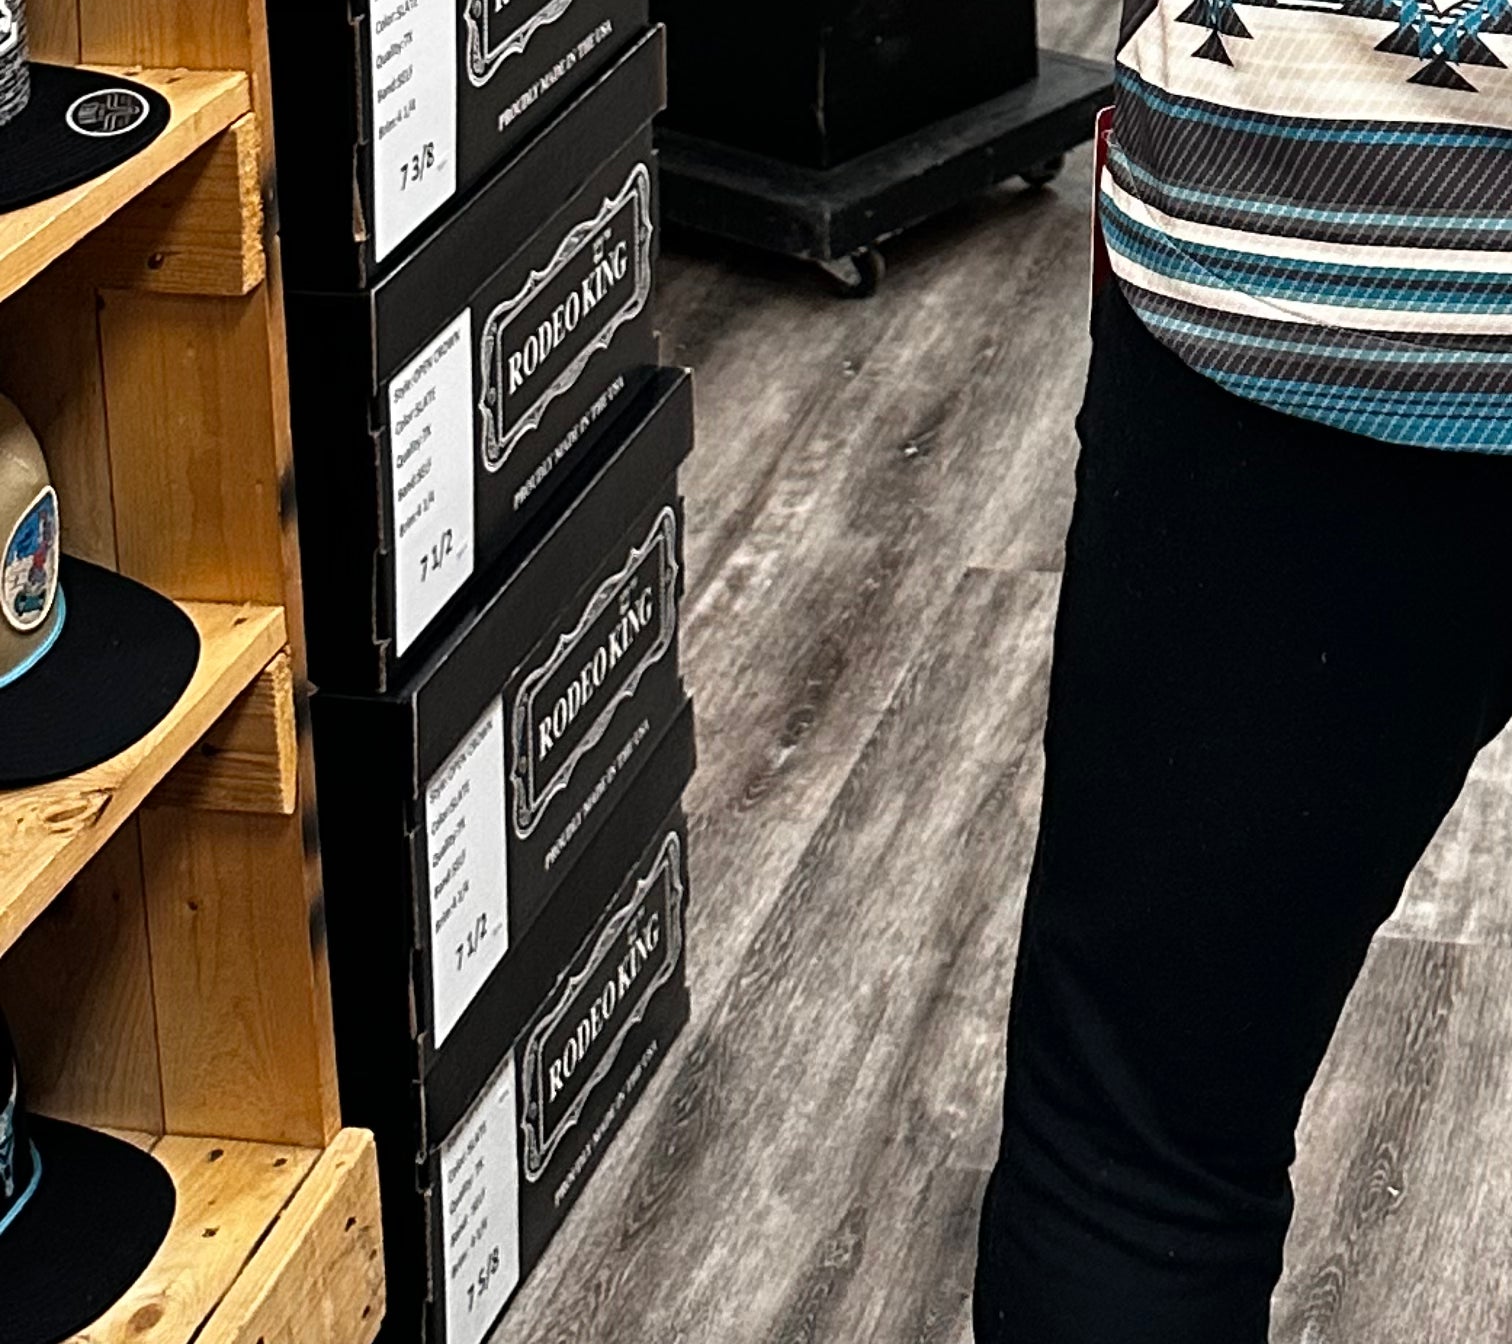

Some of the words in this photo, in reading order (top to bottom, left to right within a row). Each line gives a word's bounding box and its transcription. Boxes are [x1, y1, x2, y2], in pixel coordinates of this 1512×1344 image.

[400, 163, 408, 191] 7
[411, 142, 435, 181] 3/8
[508, 291, 580, 396] RODEO
[581, 241, 628, 318] KING
[420, 554, 429, 583] 7
[538, 646, 607, 762] RODEO
[608, 587, 653, 669] KING
[455, 942, 464, 971] 7
[549, 980, 617, 1103] RODEO
[617, 912, 660, 1000] KING
